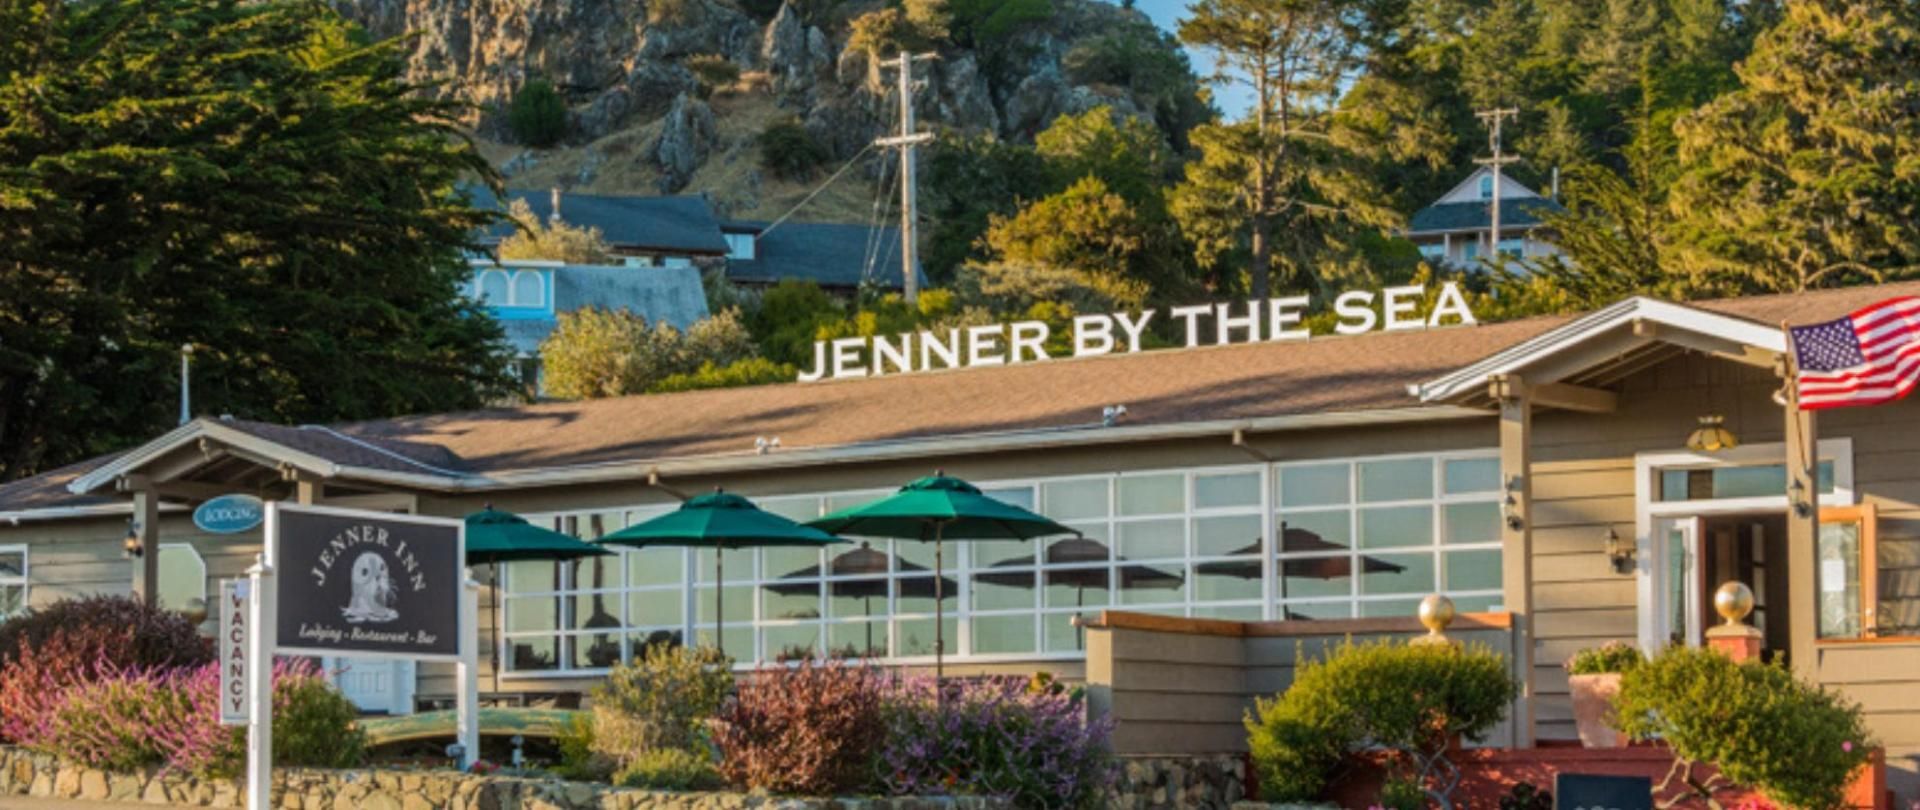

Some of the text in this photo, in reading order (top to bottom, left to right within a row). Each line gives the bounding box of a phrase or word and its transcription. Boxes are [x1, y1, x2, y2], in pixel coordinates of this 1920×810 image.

[796, 280, 1478, 383] JENNER BY THE SEA
[204, 506, 257, 523] LODGING
[311, 525, 427, 591] JENNER INN
[229, 593, 243, 713] VACANCY
[299, 622, 437, 644] Lodging Restaurant Bar
